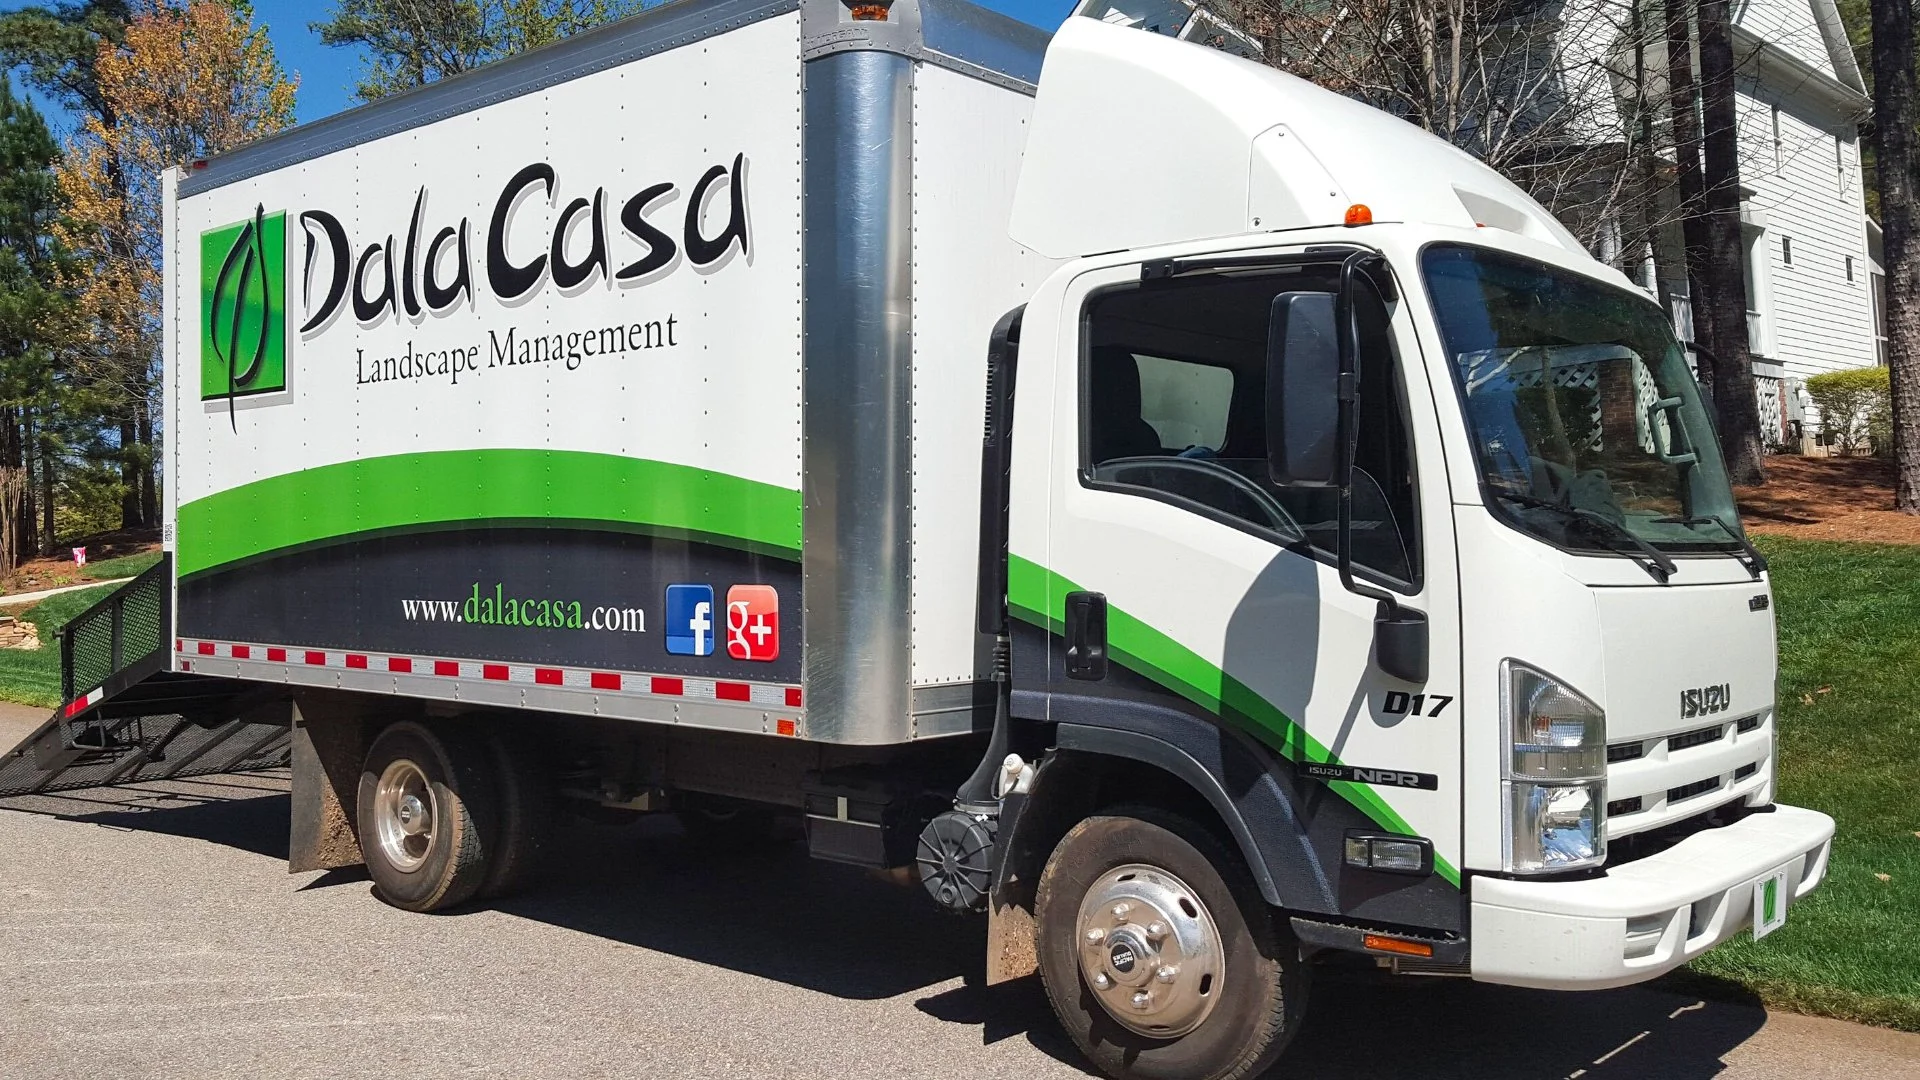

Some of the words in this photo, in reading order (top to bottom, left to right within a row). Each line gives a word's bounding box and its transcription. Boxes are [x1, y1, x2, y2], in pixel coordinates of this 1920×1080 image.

[300, 184, 473, 335] Dala
[487, 152, 749, 300] Casa
[357, 340, 479, 385] Landscape
[487, 312, 678, 371] Management
[401, 582, 646, 632] www.dalacasa.com
[1382, 690, 1453, 718] D17
[1680, 682, 1730, 719] ISUZU
[1309, 766, 1342, 777] ISUZU
[1353, 768, 1419, 787] NPR
